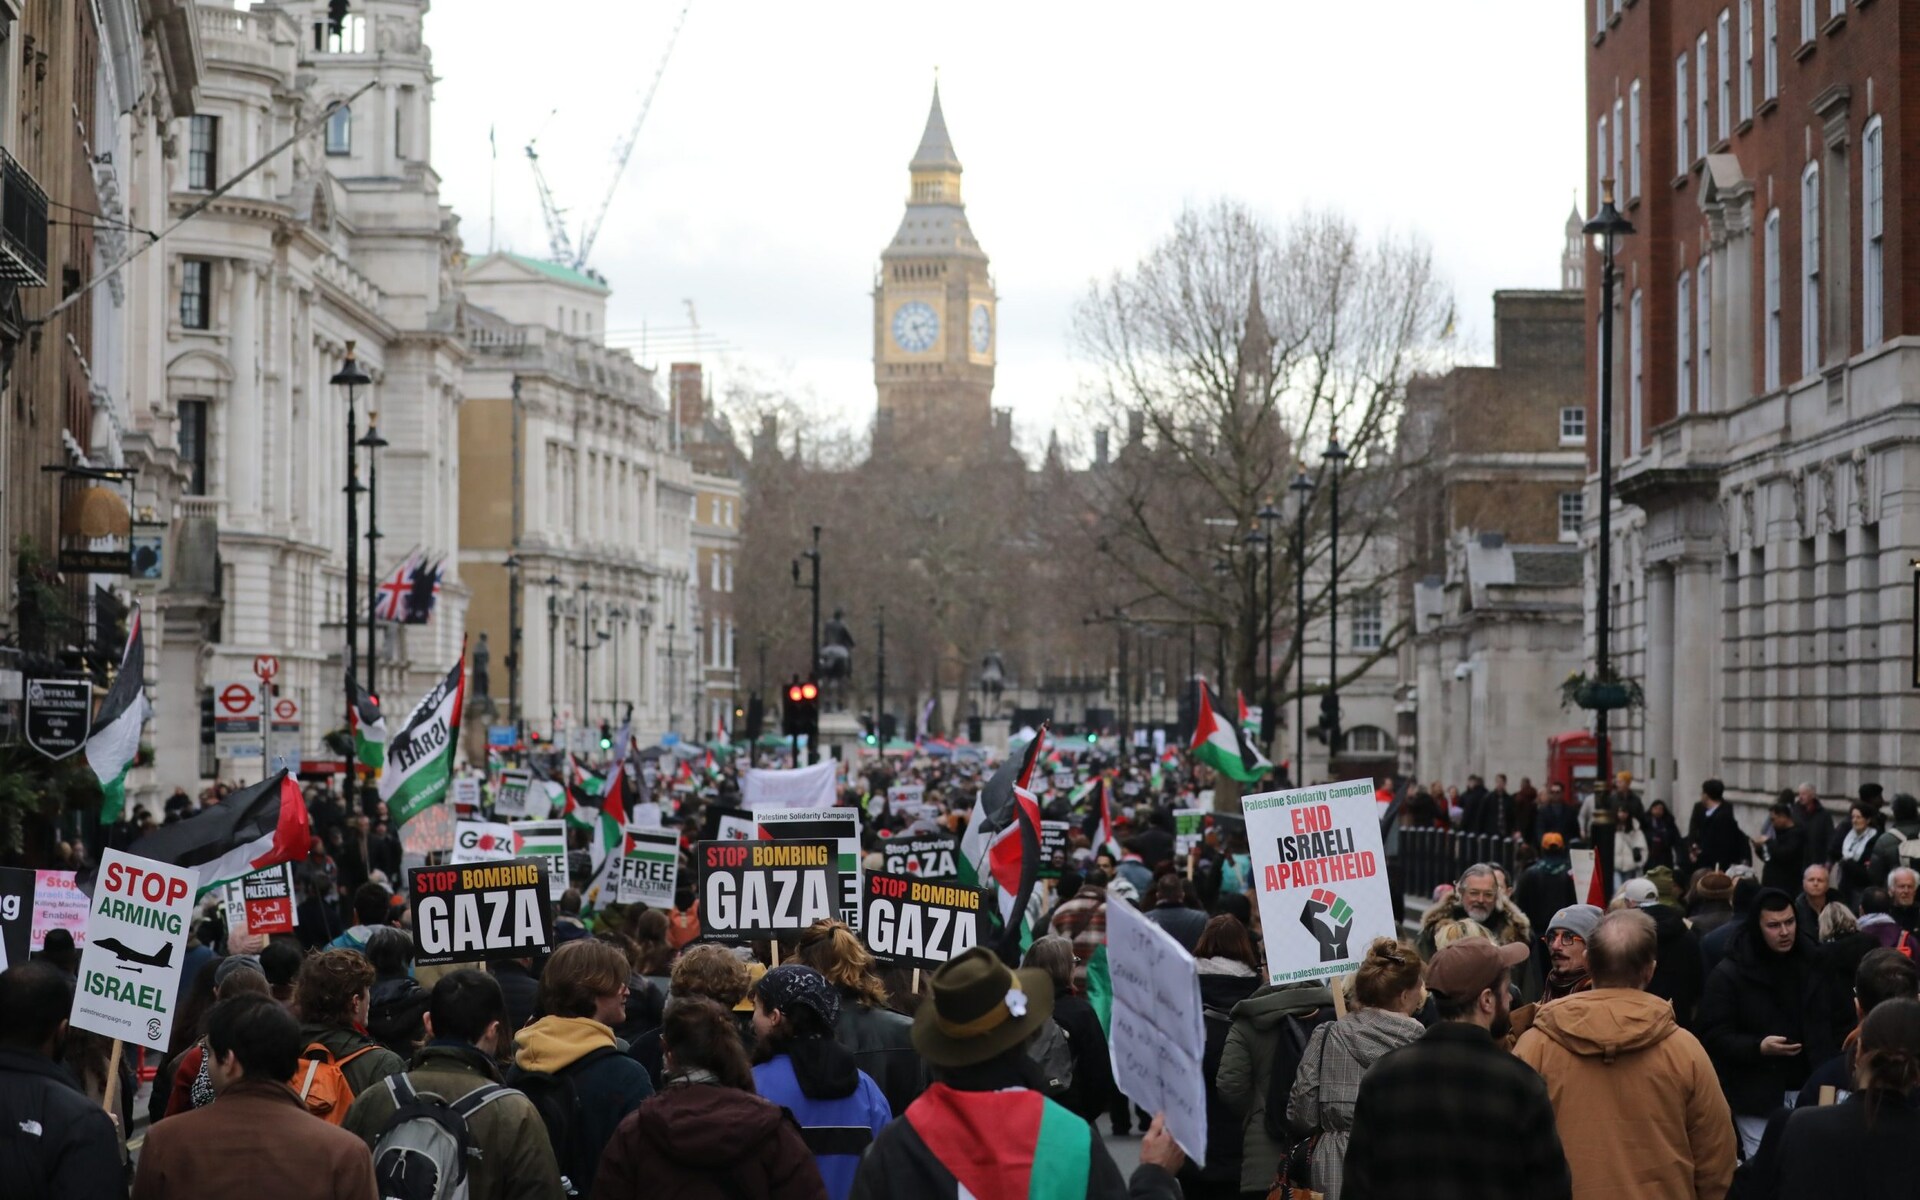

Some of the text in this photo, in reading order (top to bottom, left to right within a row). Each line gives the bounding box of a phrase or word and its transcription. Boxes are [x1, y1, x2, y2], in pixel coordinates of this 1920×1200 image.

[257, 659, 275, 676] M
[31, 700, 86, 709] MERCHANDISE
[41, 689, 77, 699] OFFICIAL
[1244, 784, 1373, 811] Palestine Solidarity Campaign
[757, 811, 855, 821] Palestine Solidarity Campaign
[1290, 804, 1333, 835] END
[707, 845, 828, 867] STOP BOMBING
[885, 840, 955, 855] Stop Starving
[1276, 827, 1355, 863] ISRAELI
[622, 859, 675, 883] FREE
[887, 851, 957, 878] GAZA
[1264, 850, 1376, 892] APARTHEID
[105, 862, 188, 906] STOP
[245, 882, 287, 899] PALESTINE
[416, 871, 458, 893] STOP
[462, 864, 539, 890] BOMBING
[621, 878, 673, 892] PALESTINE
[706, 870, 831, 930] GAZA
[871, 876, 908, 898] STOP
[911, 882, 980, 910] BOMBING
[42, 911, 79, 920] Enabled
[98, 897, 182, 935] ARMING
[418, 888, 546, 955] GAZA
[867, 898, 978, 962] GAZA
[1272, 962, 1361, 981] www.palestinecampaign
[84, 970, 167, 1013] ISRAEL
[80, 1007, 132, 1027] palestinecampaign.org
